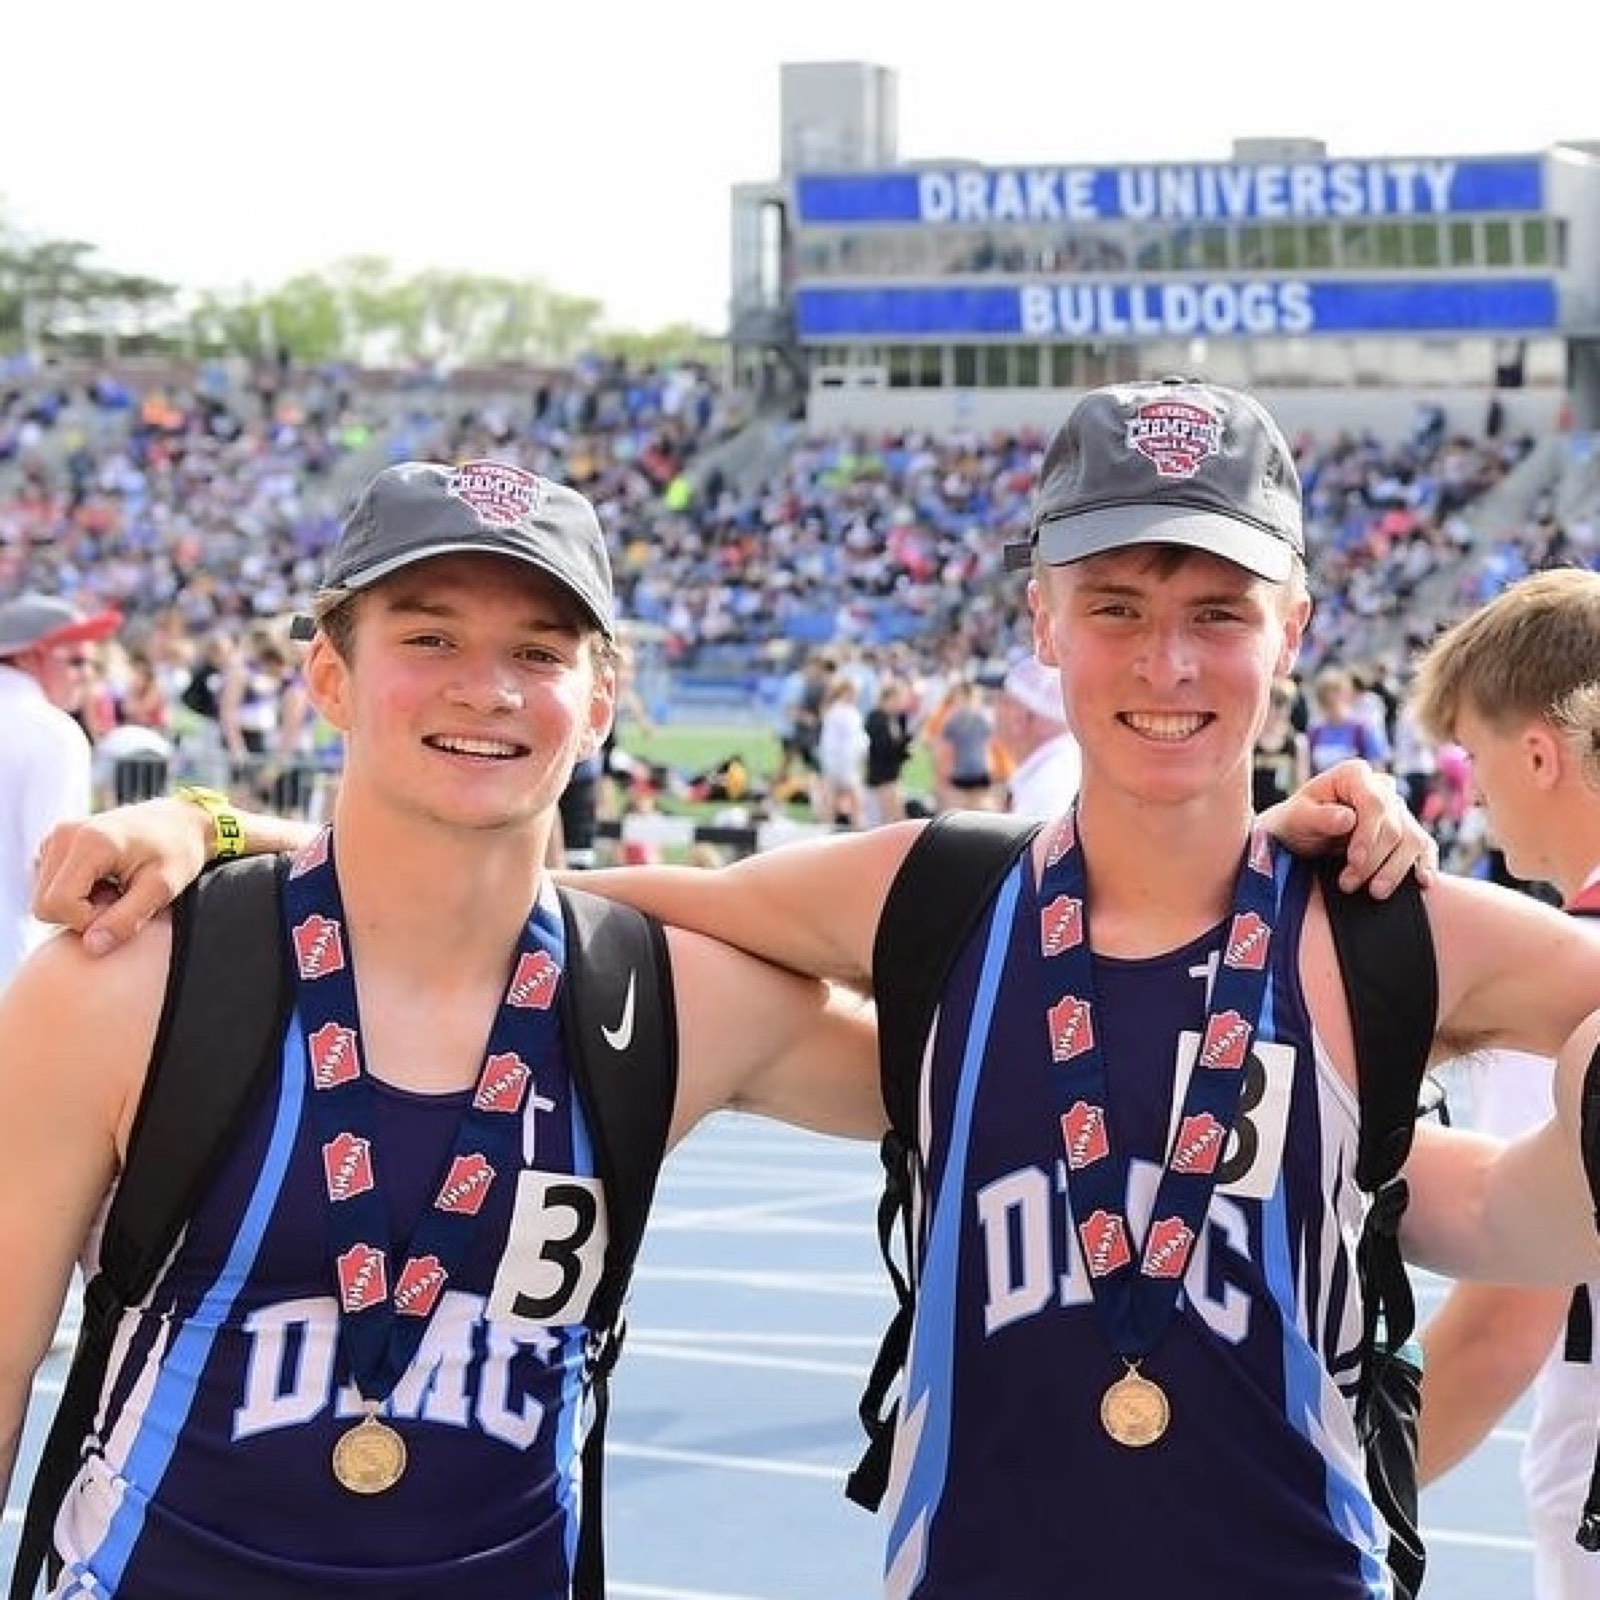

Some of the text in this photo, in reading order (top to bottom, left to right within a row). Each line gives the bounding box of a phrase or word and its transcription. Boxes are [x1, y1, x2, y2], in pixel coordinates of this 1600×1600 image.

[918, 161, 1457, 223] DRAKE UNIVERSITY
[1021, 282, 1316, 335] BULLDOGS
[511, 1183, 598, 1320] 3
